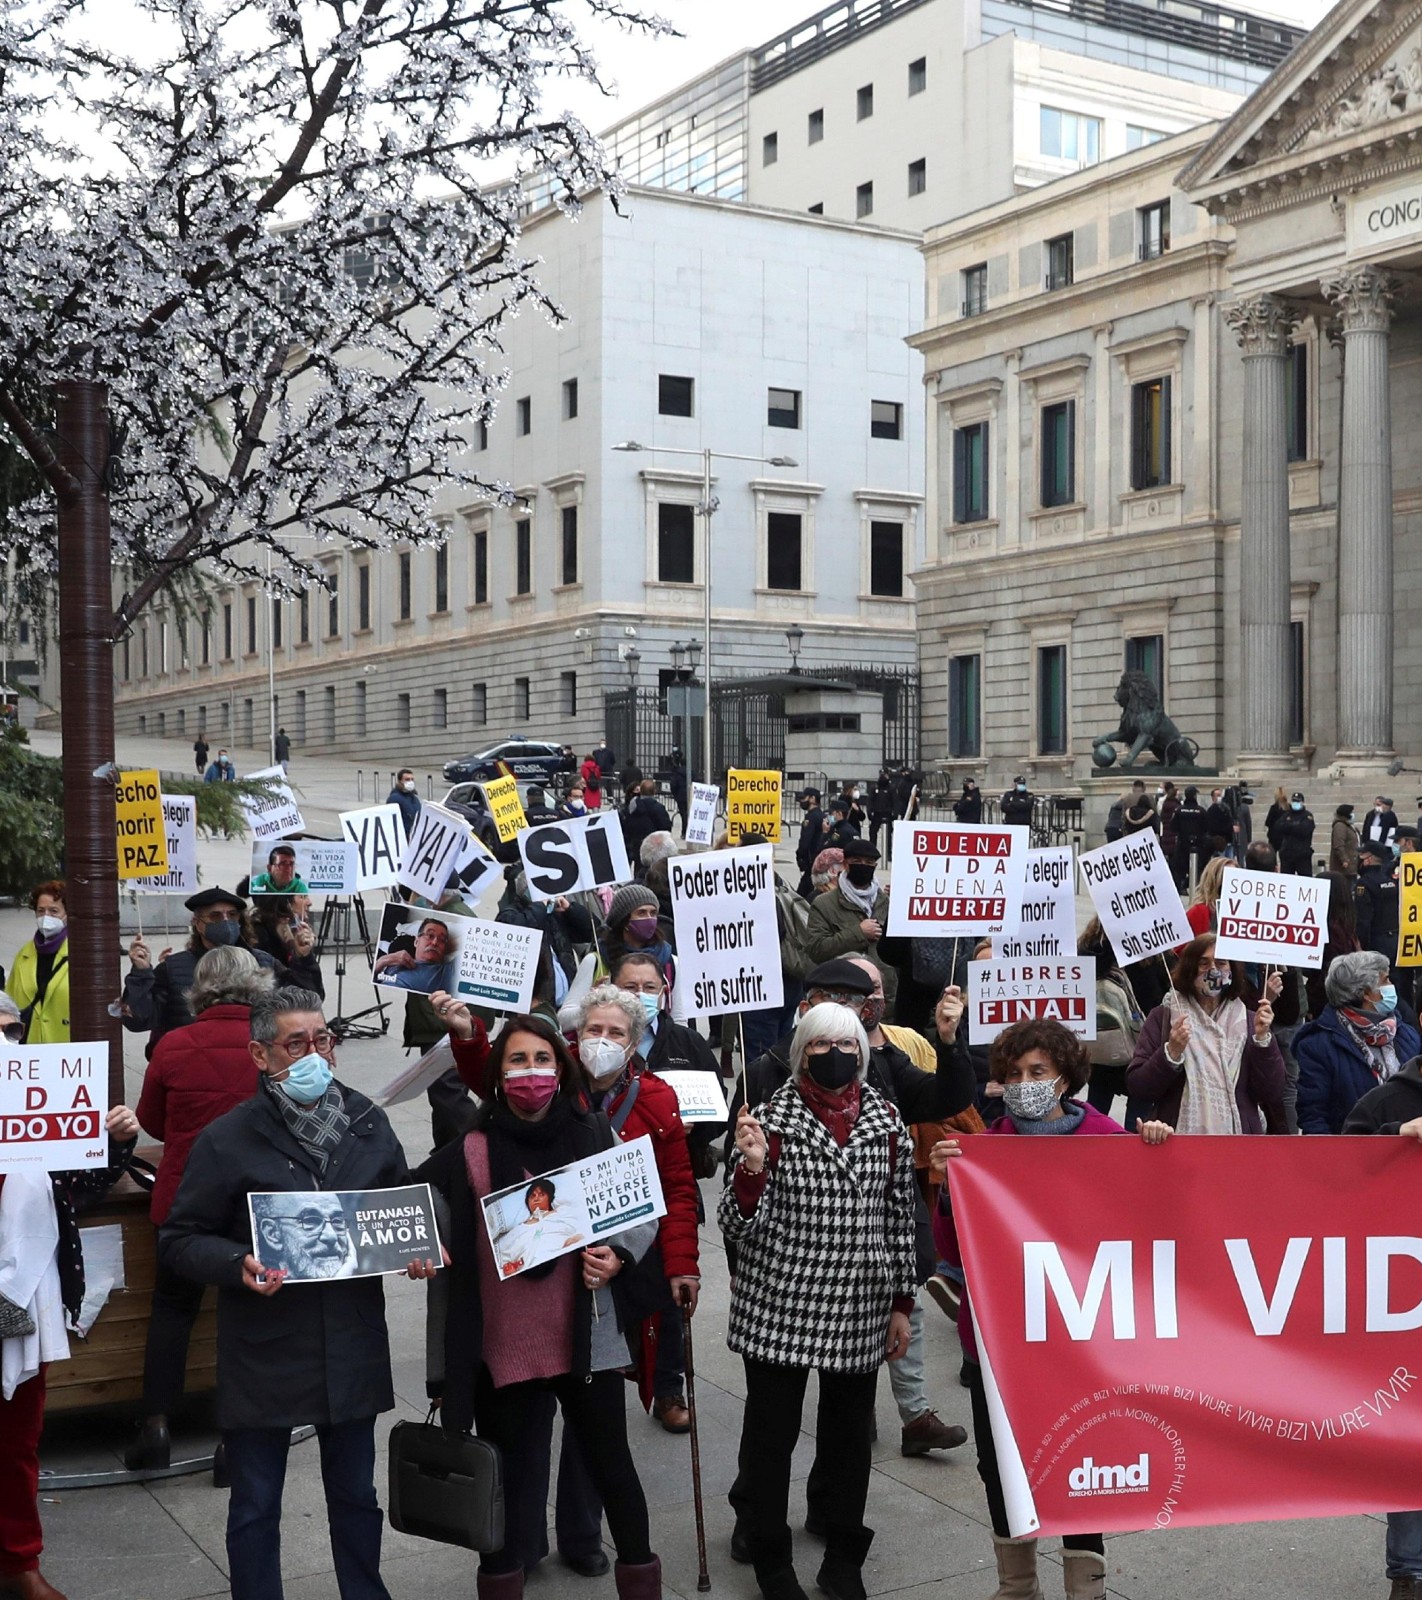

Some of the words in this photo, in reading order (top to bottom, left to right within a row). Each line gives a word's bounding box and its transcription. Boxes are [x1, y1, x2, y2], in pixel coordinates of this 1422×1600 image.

[487, 782, 515, 800] Derecho
[730, 776, 778, 791] Derecho
[495, 809, 501, 818] a
[500, 799, 518, 816] morir
[733, 803, 739, 814] a
[744, 800, 775, 814] morir
[255, 821, 280, 837] nunca
[281, 809, 301, 828] más!
[499, 822, 511, 836] EN
[731, 822, 747, 837] EN
[751, 823, 778, 837] PAZ.
[345, 813, 403, 877] YA!
[409, 815, 458, 886] YA!
[917, 835, 1008, 854] BUENA
[124, 845, 164, 868] PAZ.
[524, 817, 616, 895] SÍ
[916, 856, 1006, 874] VIDA
[1082, 854, 1121, 886] Poder
[1122, 838, 1156, 872] elegir
[672, 862, 720, 901] Poder
[723, 854, 768, 901] elegir
[1032, 855, 1069, 888] elegir
[914, 878, 1004, 895] BUENA
[1230, 879, 1286, 899] SOBRE
[1298, 887, 1318, 903] MI
[912, 899, 1003, 916] MUERTE
[1022, 896, 1056, 922] morir
[1111, 892, 1125, 918] el
[1123, 880, 1158, 914] morir
[1229, 898, 1316, 924] VIDA
[1408, 904, 1417, 922] a
[468, 927, 498, 938] ¿POR
[507, 933, 530, 944] QUÉ
[696, 916, 708, 953] el
[713, 911, 754, 950] morir
[1121, 932, 1143, 958] sin
[1141, 918, 1180, 951] sufrir.
[1226, 920, 1288, 941] DECIDO
[1292, 927, 1315, 944] YO
[1002, 937, 1021, 959] sin
[1025, 934, 1062, 956] sufrir.
[464, 951, 525, 970] SALVARTE
[460, 970, 475, 978] QUE
[491, 975, 522, 986] SALVEN?
[495, 968, 524, 978] QUIERES
[981, 966, 1081, 982] #LIBRES
[695, 970, 717, 1010] sin
[720, 966, 767, 1006] sufrir.
[981, 984, 1047, 998] HASTA
[1062, 984, 1081, 995] EL
[982, 998, 1082, 1023] FINAL
[61, 1057, 91, 1079] MI
[56, 1115, 92, 1137] YO
[580, 1168, 591, 1178] ES
[597, 1161, 610, 1171] MI
[616, 1149, 642, 1164] VIDA
[629, 1158, 644, 1168] NO
[583, 1177, 615, 1195] TIENE
[624, 1165, 646, 1180] QUE
[586, 1175, 648, 1206] METERSE
[356, 1205, 424, 1221] EUTANASIA
[588, 1186, 651, 1219] NADIE
[389, 1219, 409, 1227] ACTO
[360, 1225, 428, 1246] AMOR
[1023, 1239, 1176, 1342] MI
[1051, 1413, 1070, 1432] VIURE
[1070, 1398, 1091, 1414] VIVIR
[1093, 1389, 1110, 1402] BIZI
[1113, 1383, 1140, 1396] VIURE
[1144, 1383, 1169, 1395] VIVIR
[1173, 1385, 1195, 1402] BIZI
[1199, 1391, 1234, 1418] VIURE
[1237, 1406, 1274, 1434] VIVIR
[1276, 1419, 1308, 1441] BIZI
[1311, 1406, 1370, 1441] VIURE
[1363, 1366, 1418, 1417] VIVIR
[1109, 1408, 1122, 1418] HIL
[1076, 1412, 1108, 1436] MORRER
[1125, 1407, 1159, 1427] MORIR
[1057, 1433, 1077, 1455] MORIR
[1157, 1420, 1186, 1471] MORRER
[1068, 1453, 1149, 1491] dmd
[1168, 1473, 1186, 1494] HIL
